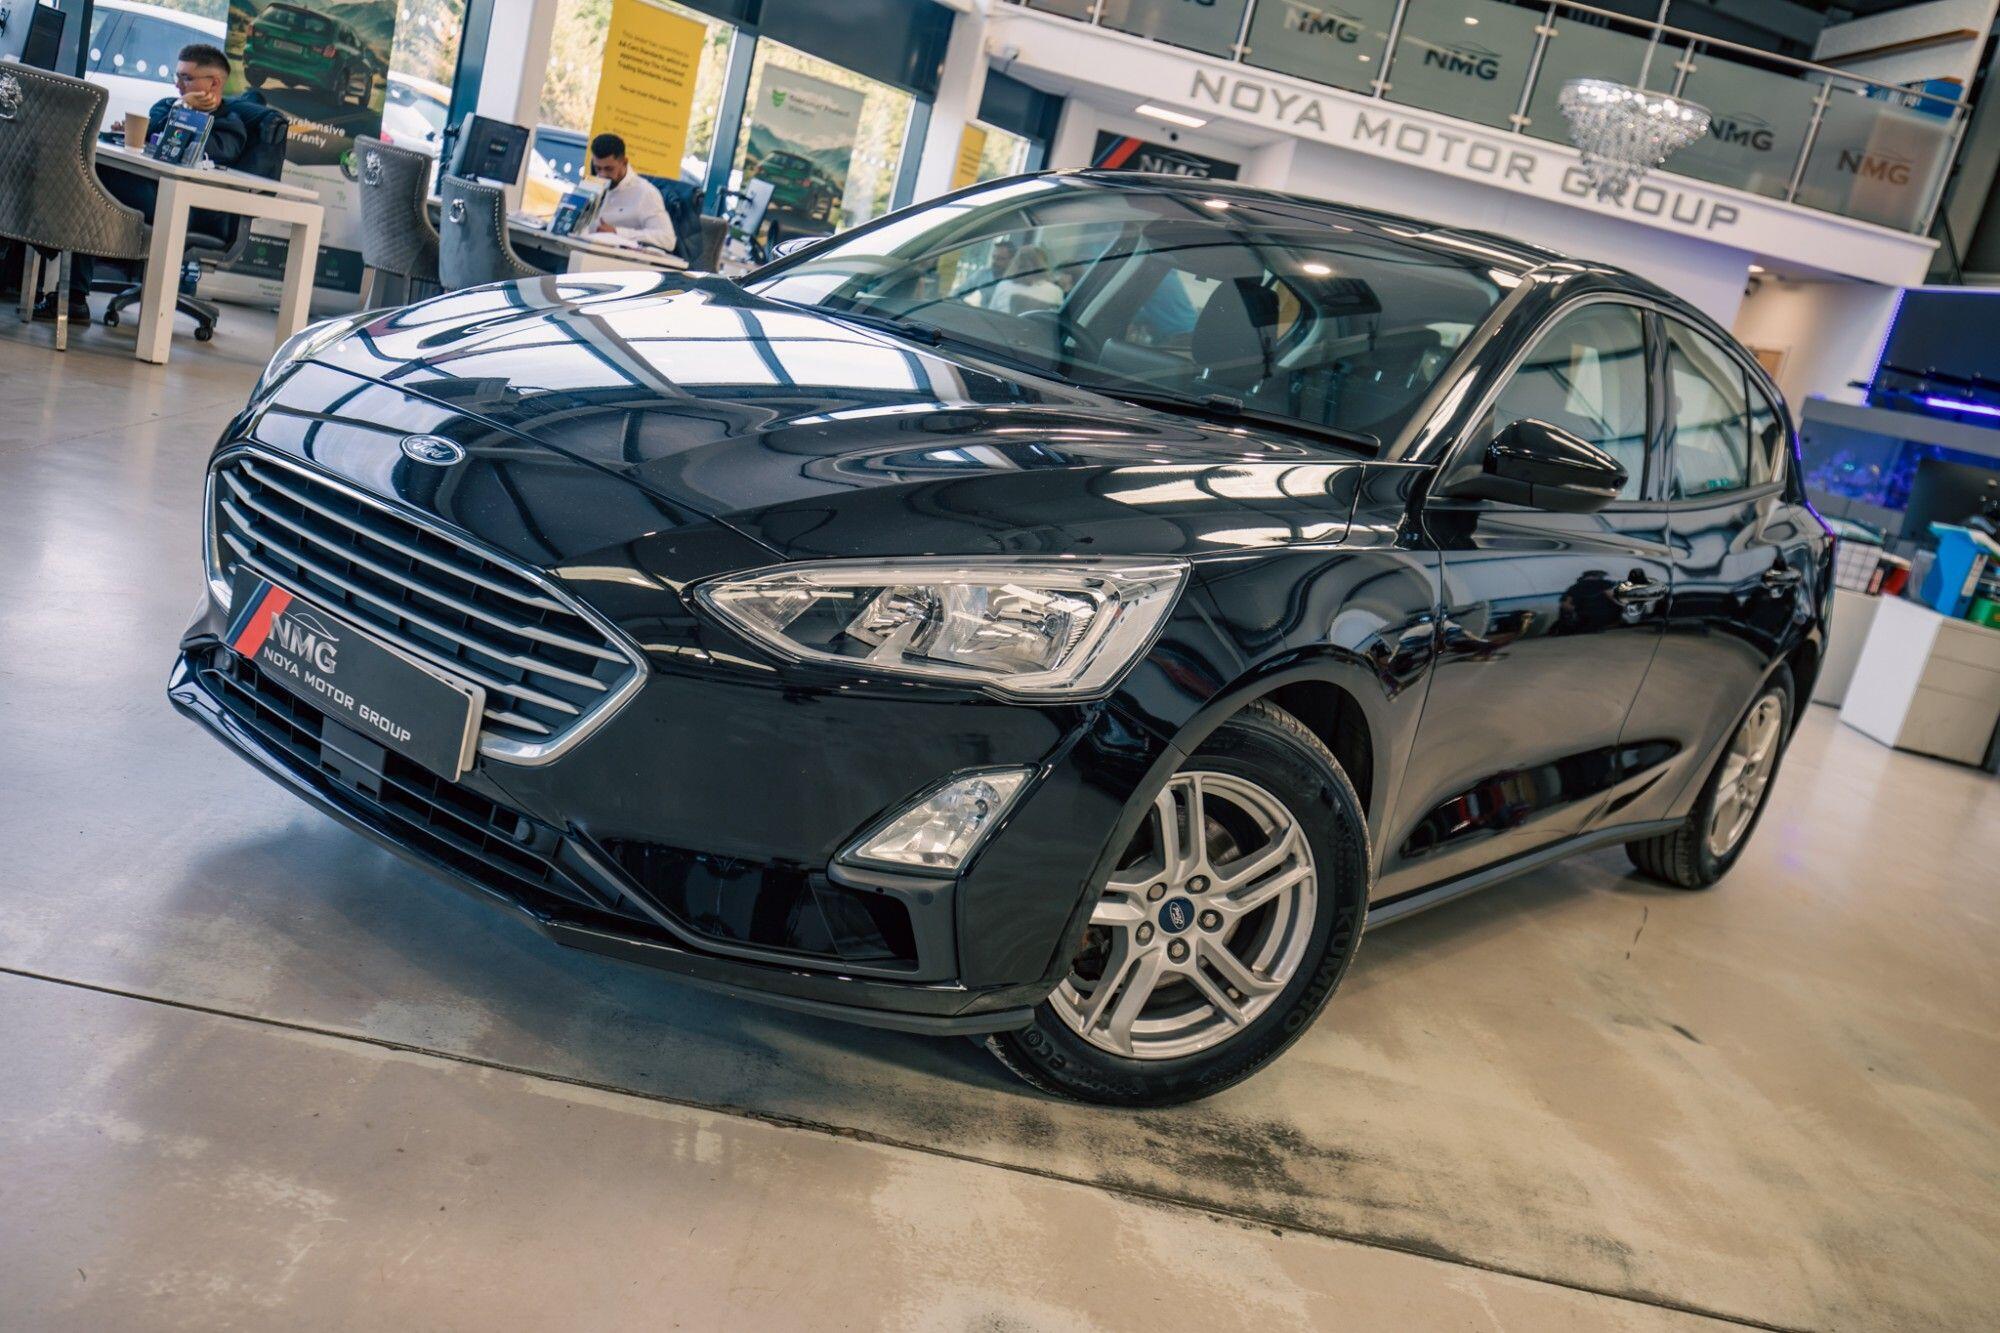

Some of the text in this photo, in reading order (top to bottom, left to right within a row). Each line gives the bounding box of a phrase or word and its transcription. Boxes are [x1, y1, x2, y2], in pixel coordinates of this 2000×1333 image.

[1423, 48, 1499, 81] NMG
[1190, 69, 1327, 132] NOYA
[1352, 111, 1537, 184] MOTOR
[1837, 149, 1911, 186] NMG
[267, 611, 339, 675] NMG
[263, 646, 412, 743] NOYA MOTOR GROUP
[1284, 905, 1358, 1033] KUMHO
